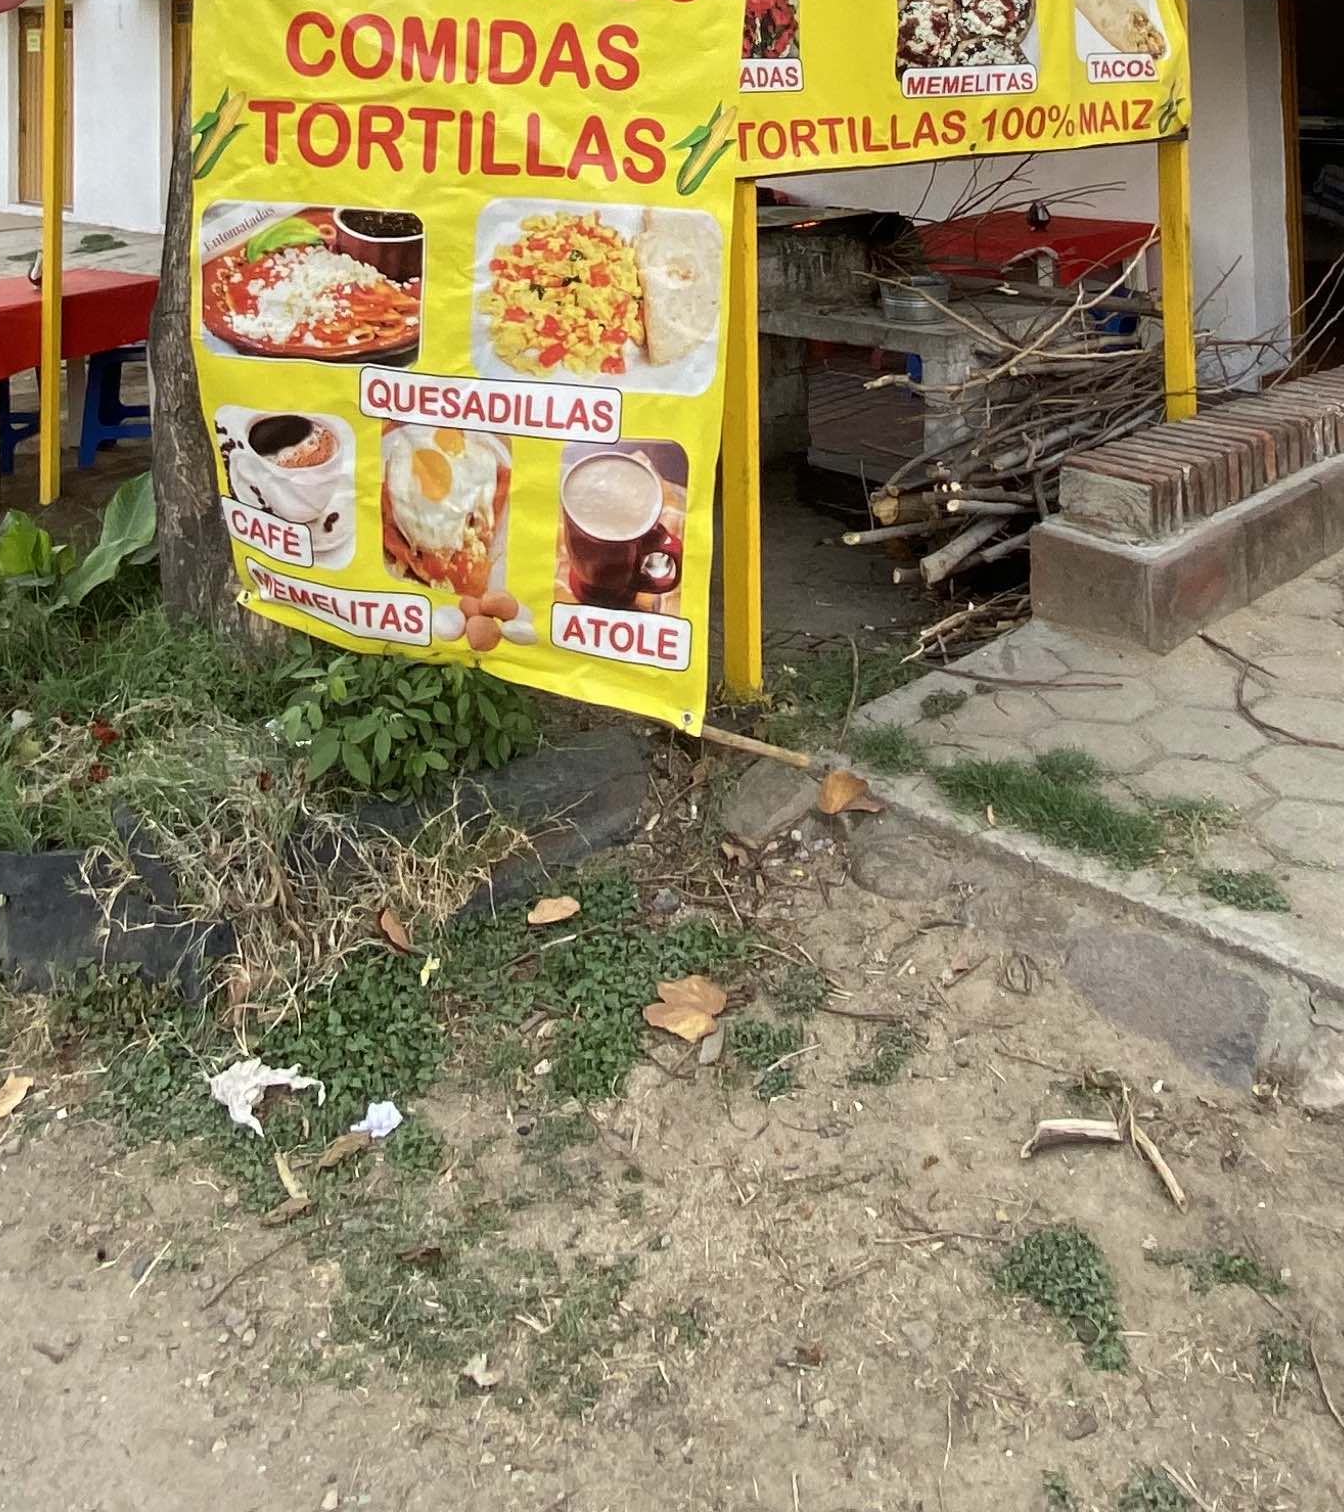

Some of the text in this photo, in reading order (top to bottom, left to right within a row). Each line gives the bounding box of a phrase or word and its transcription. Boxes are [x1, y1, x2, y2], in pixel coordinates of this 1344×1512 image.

[285, 10, 641, 91] COMIDAS
[1090, 60, 1156, 79] TACOS
[906, 71, 1035, 96] MEMELITAS
[248, 99, 666, 185] TORTILLAS
[736, 98, 1154, 162] TORTILLAS 100% MAIZ
[203, 207, 276, 252] Entomatadas
[367, 379, 615, 434] QUESADILLAS
[230, 509, 302, 558] CAFÉ
[251, 568, 424, 634] MEMELITAS
[562, 614, 679, 662] ATOLE
